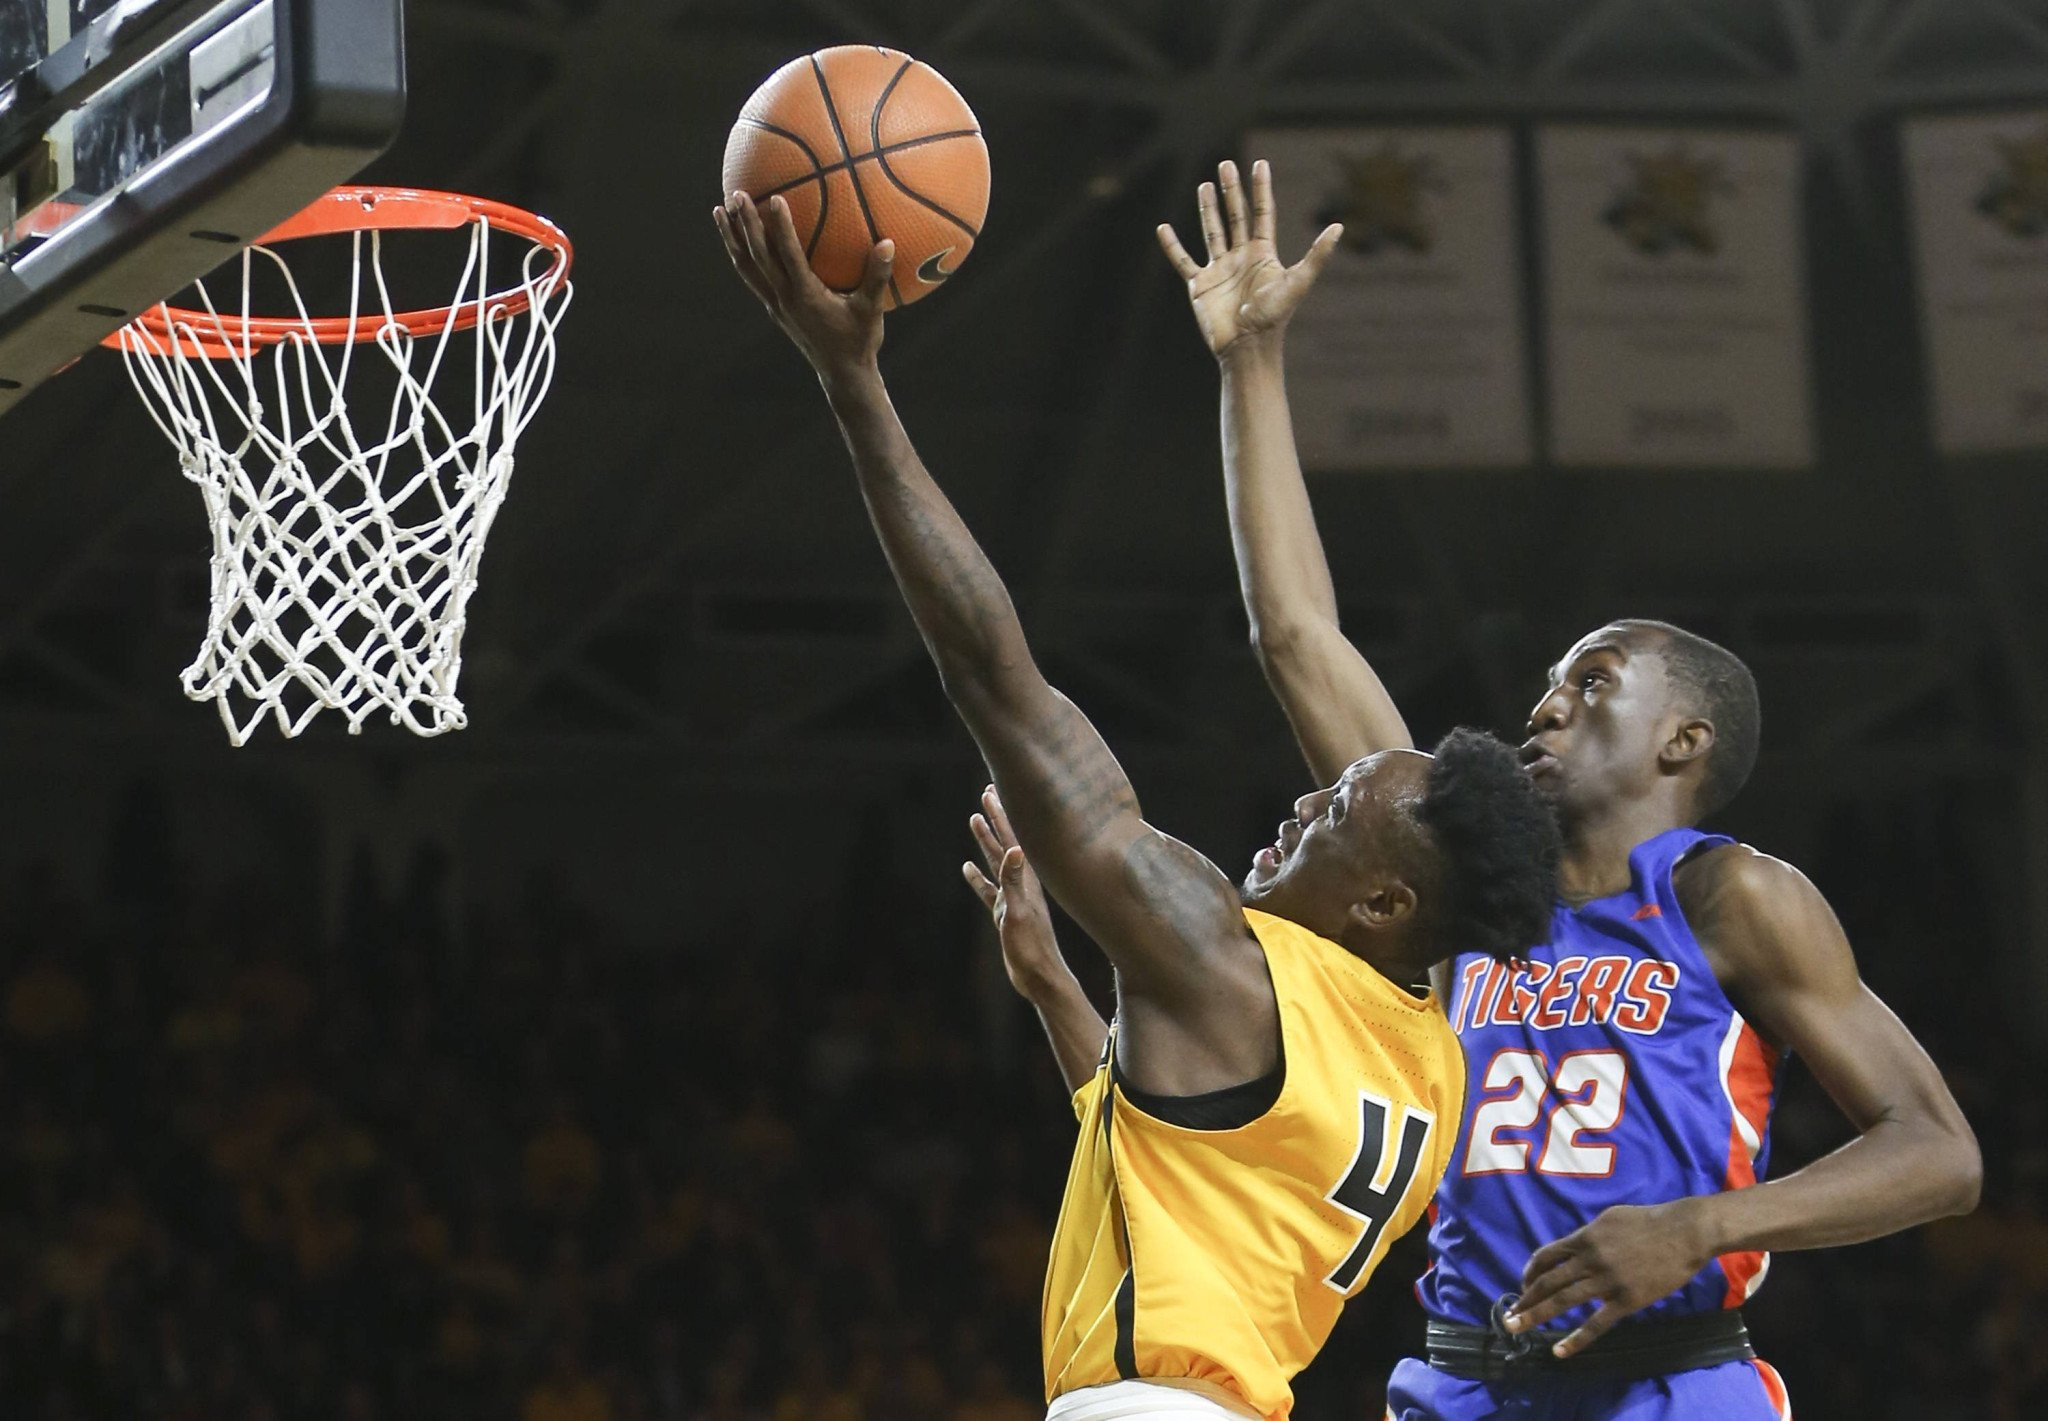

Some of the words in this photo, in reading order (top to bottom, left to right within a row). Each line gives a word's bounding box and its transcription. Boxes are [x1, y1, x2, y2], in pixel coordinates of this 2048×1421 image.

[1454, 956, 1681, 1035] TIGERS
[1462, 1047, 1629, 1178] 22
[1322, 1088, 1437, 1295] 4
